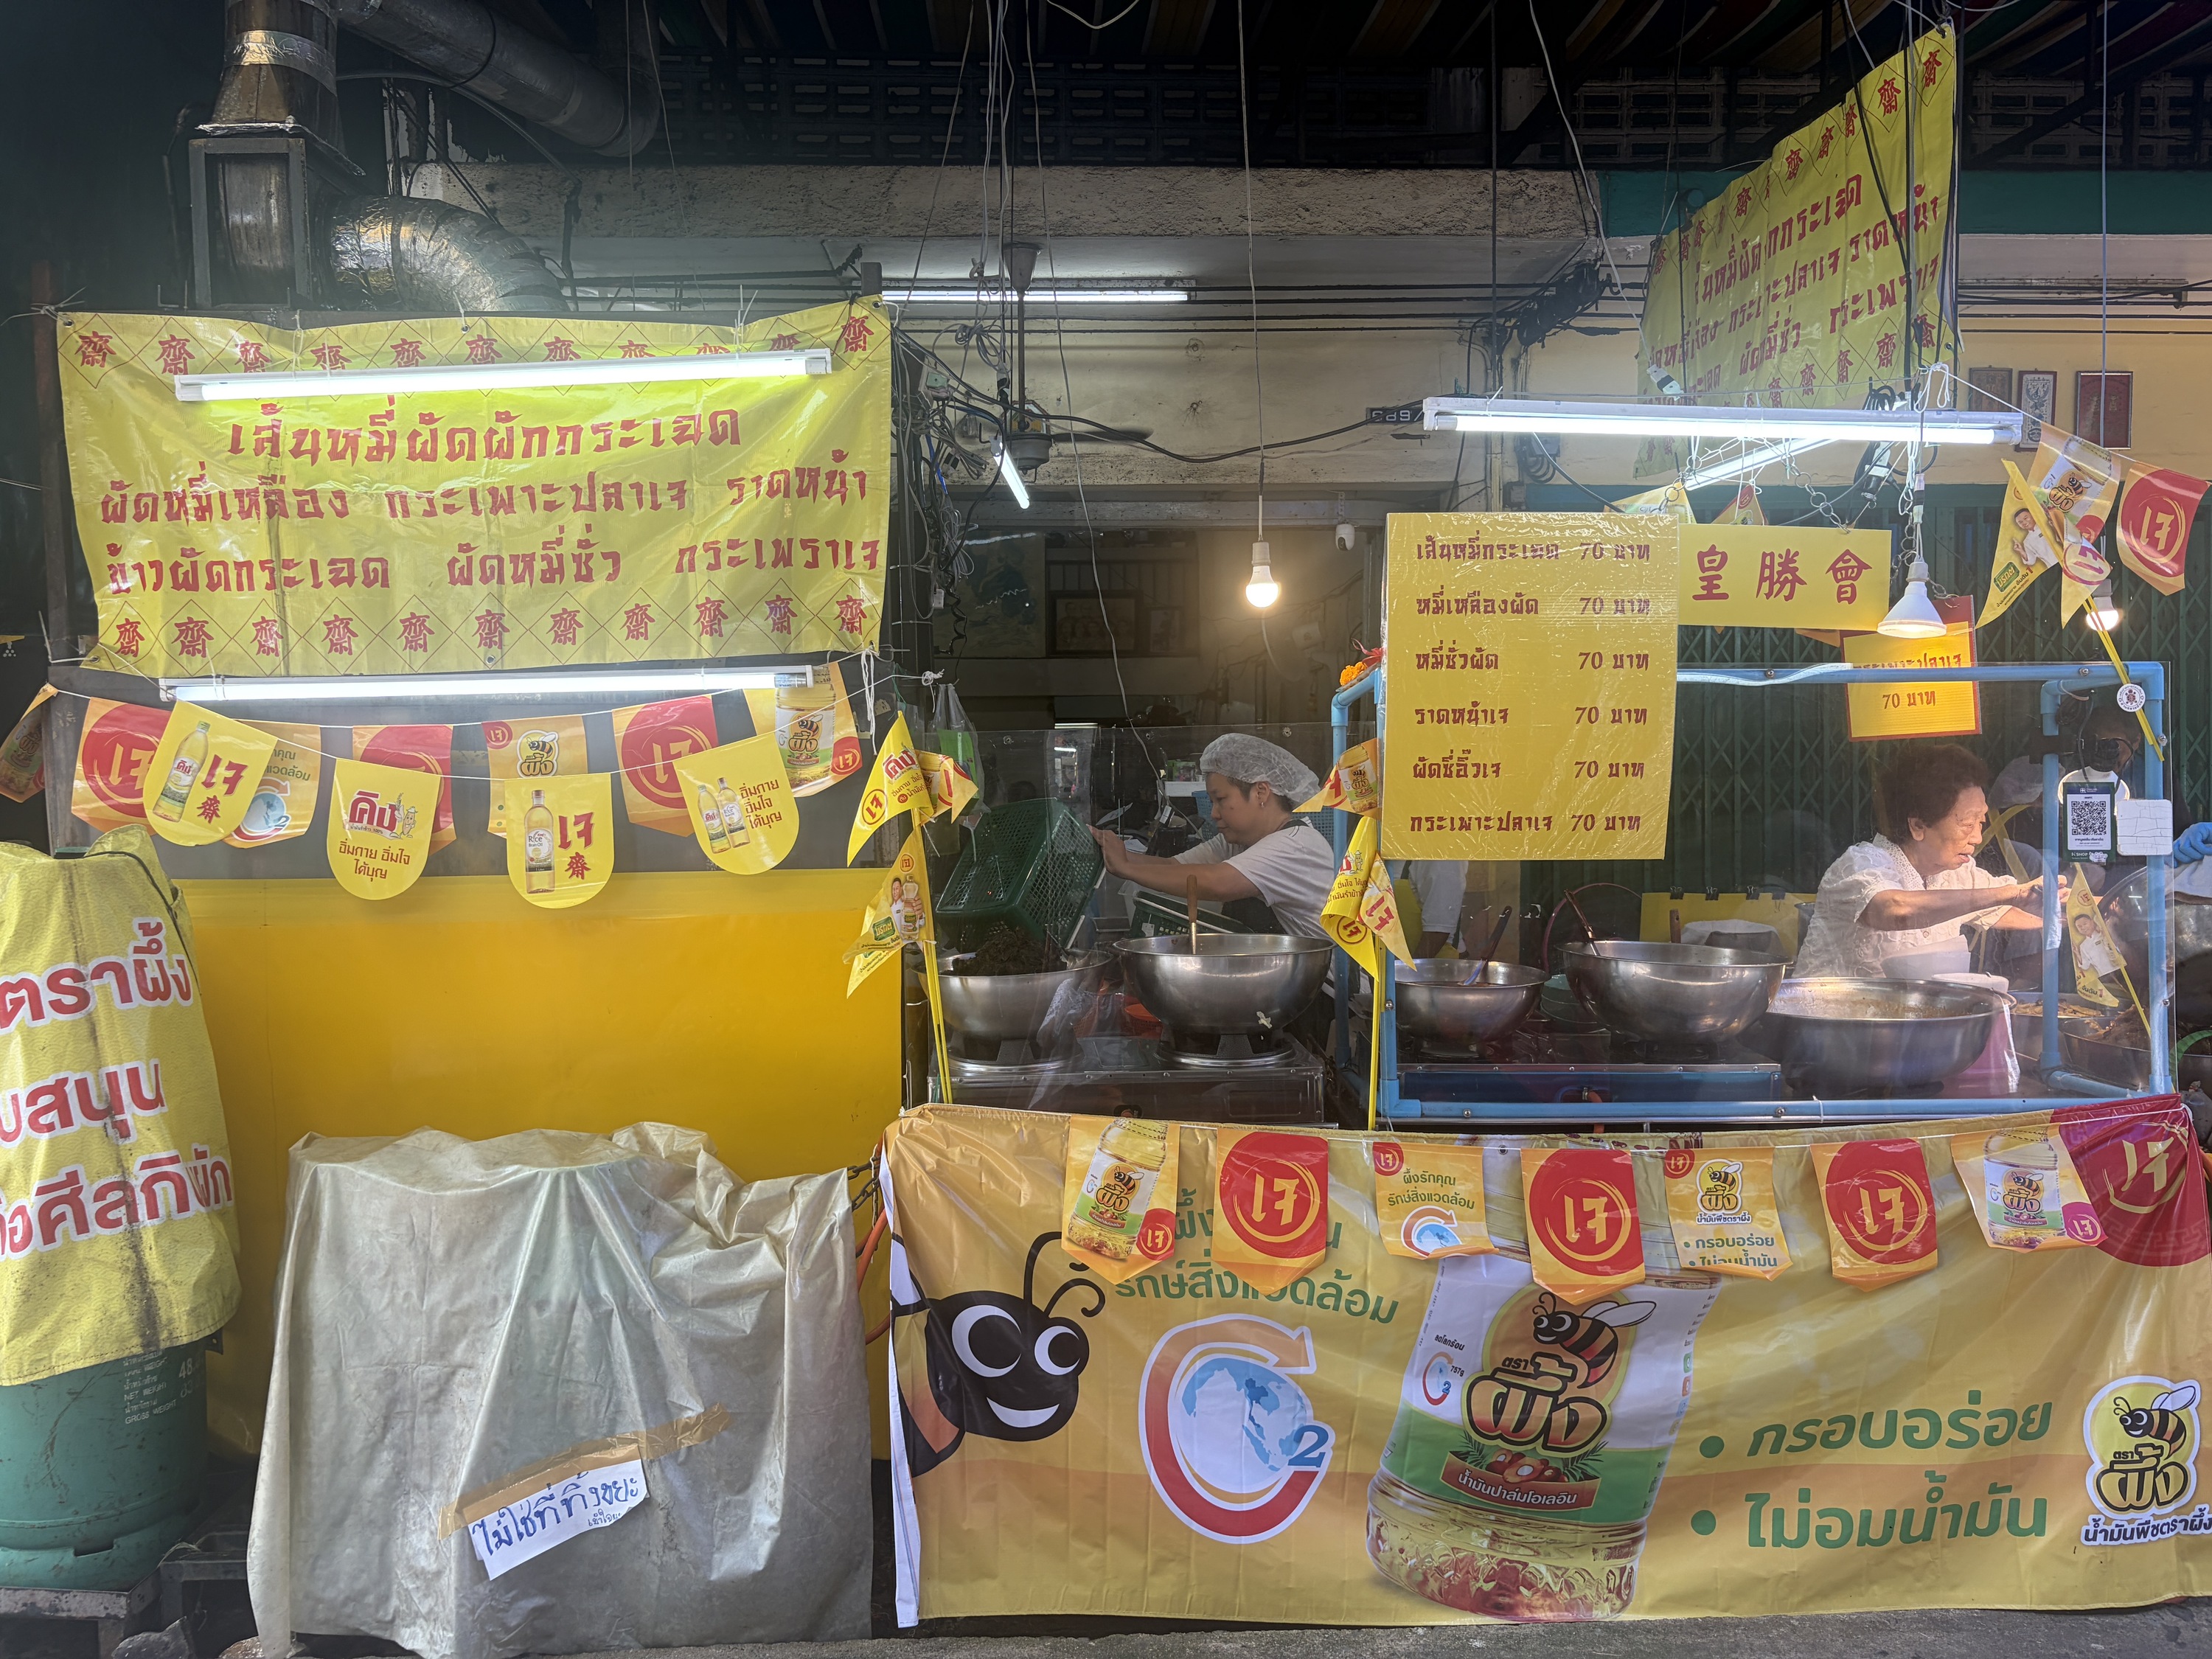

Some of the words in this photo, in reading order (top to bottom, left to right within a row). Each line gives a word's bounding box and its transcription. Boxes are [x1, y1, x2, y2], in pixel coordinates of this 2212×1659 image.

[1877, 77, 1902, 117] 齋
[1923, 49, 1942, 89] 齋
[74, 331, 116, 367] 齋
[156, 334, 195, 375] 齋
[101, 461, 349, 526] ผัดหมี่เหลือง
[386, 472, 687, 518] กระเพาะปลาเจ
[728, 449, 866, 506] ราดหน้า
[2140, 506, 2175, 551] เจ
[107, 543, 390, 594] ข้าวผัดกระเฉด
[676, 538, 880, 574] กระเพราเจ
[1580, 542, 1604, 561] 70
[1614, 542, 1650, 563] บาท
[1691, 543, 1873, 605] 皇勝會
[1416, 585, 1540, 616] หมี่เหลืองผัด
[1579, 597, 1604, 615] 70
[1613, 597, 1650, 616] บาท
[114, 618, 146, 657] 齋
[172, 617, 214, 658] 齋
[252, 616, 284, 657] 齋
[323, 614, 359, 656] 齋
[398, 612, 434, 653] 齋
[476, 609, 510, 650] 齋
[548, 608, 584, 646] 齋
[624, 603, 656, 641] 齋
[694, 597, 729, 638] 齋
[765, 594, 799, 636] 齋
[835, 594, 867, 636] 齋
[1578, 651, 1603, 670] 70
[1613, 653, 1649, 672] บาท
[1415, 700, 1509, 727] ราดหน้าเจ
[1575, 706, 1600, 725] 70
[1610, 706, 1648, 726] บาท
[1882, 693, 1901, 709] 70
[1907, 691, 1938, 707] บาท
[201, 754, 248, 796] เจ
[1573, 760, 1599, 779] 70
[1608, 761, 1645, 780] บาท
[740, 779, 779, 799] อิ่มกาย
[197, 795, 220, 824] 齋
[745, 796, 773, 813] อิ่มใจ
[865, 793, 883, 820] เจ
[558, 812, 595, 849] เจ
[746, 811, 782, 830] ได้บุญ
[1410, 811, 1553, 833] กระเพาะปลาเจ
[1571, 814, 1596, 832] 70
[1604, 814, 1641, 833] บาท
[339, 838, 378, 859] อิ่มกาย
[381, 846, 411, 865] อิ่มใจ
[354, 859, 388, 882] ได้บุญ
[565, 852, 591, 880] 齋
[0, 922, 192, 1029] ตราผึ้ง
[1403, 1168, 1455, 1187] ผึ้งรักคุณ
[2121, 1136, 2174, 1192] เจ
[1252, 1174, 1300, 1225] เจ
[1388, 1186, 1475, 1210] รักษ์สิ่งแวดล้อม
[1859, 1184, 1906, 1234] เจ
[1562, 1194, 1608, 1245] เจ
[2073, 1219, 2093, 1237] เจ
[1147, 1228, 1164, 1248] เจ
[1696, 1233, 1775, 1248] กรอบอร่อย
[1450, 1366, 1465, 1377] 757g
[1501, 1357, 1528, 1370] ตรา
[1466, 1353, 1607, 1452] ผึ้ง
[1747, 1389, 2052, 1458] กรอบอร่อย
[2113, 1451, 2134, 1459] ตรา
[1458, 1470, 1578, 1506] น้ำมันปาล์มโอเลอิน
[2096, 1443, 2188, 1512] ผึ้ง
[1745, 1470, 2047, 1548] ไม่อมน้ำมัน
